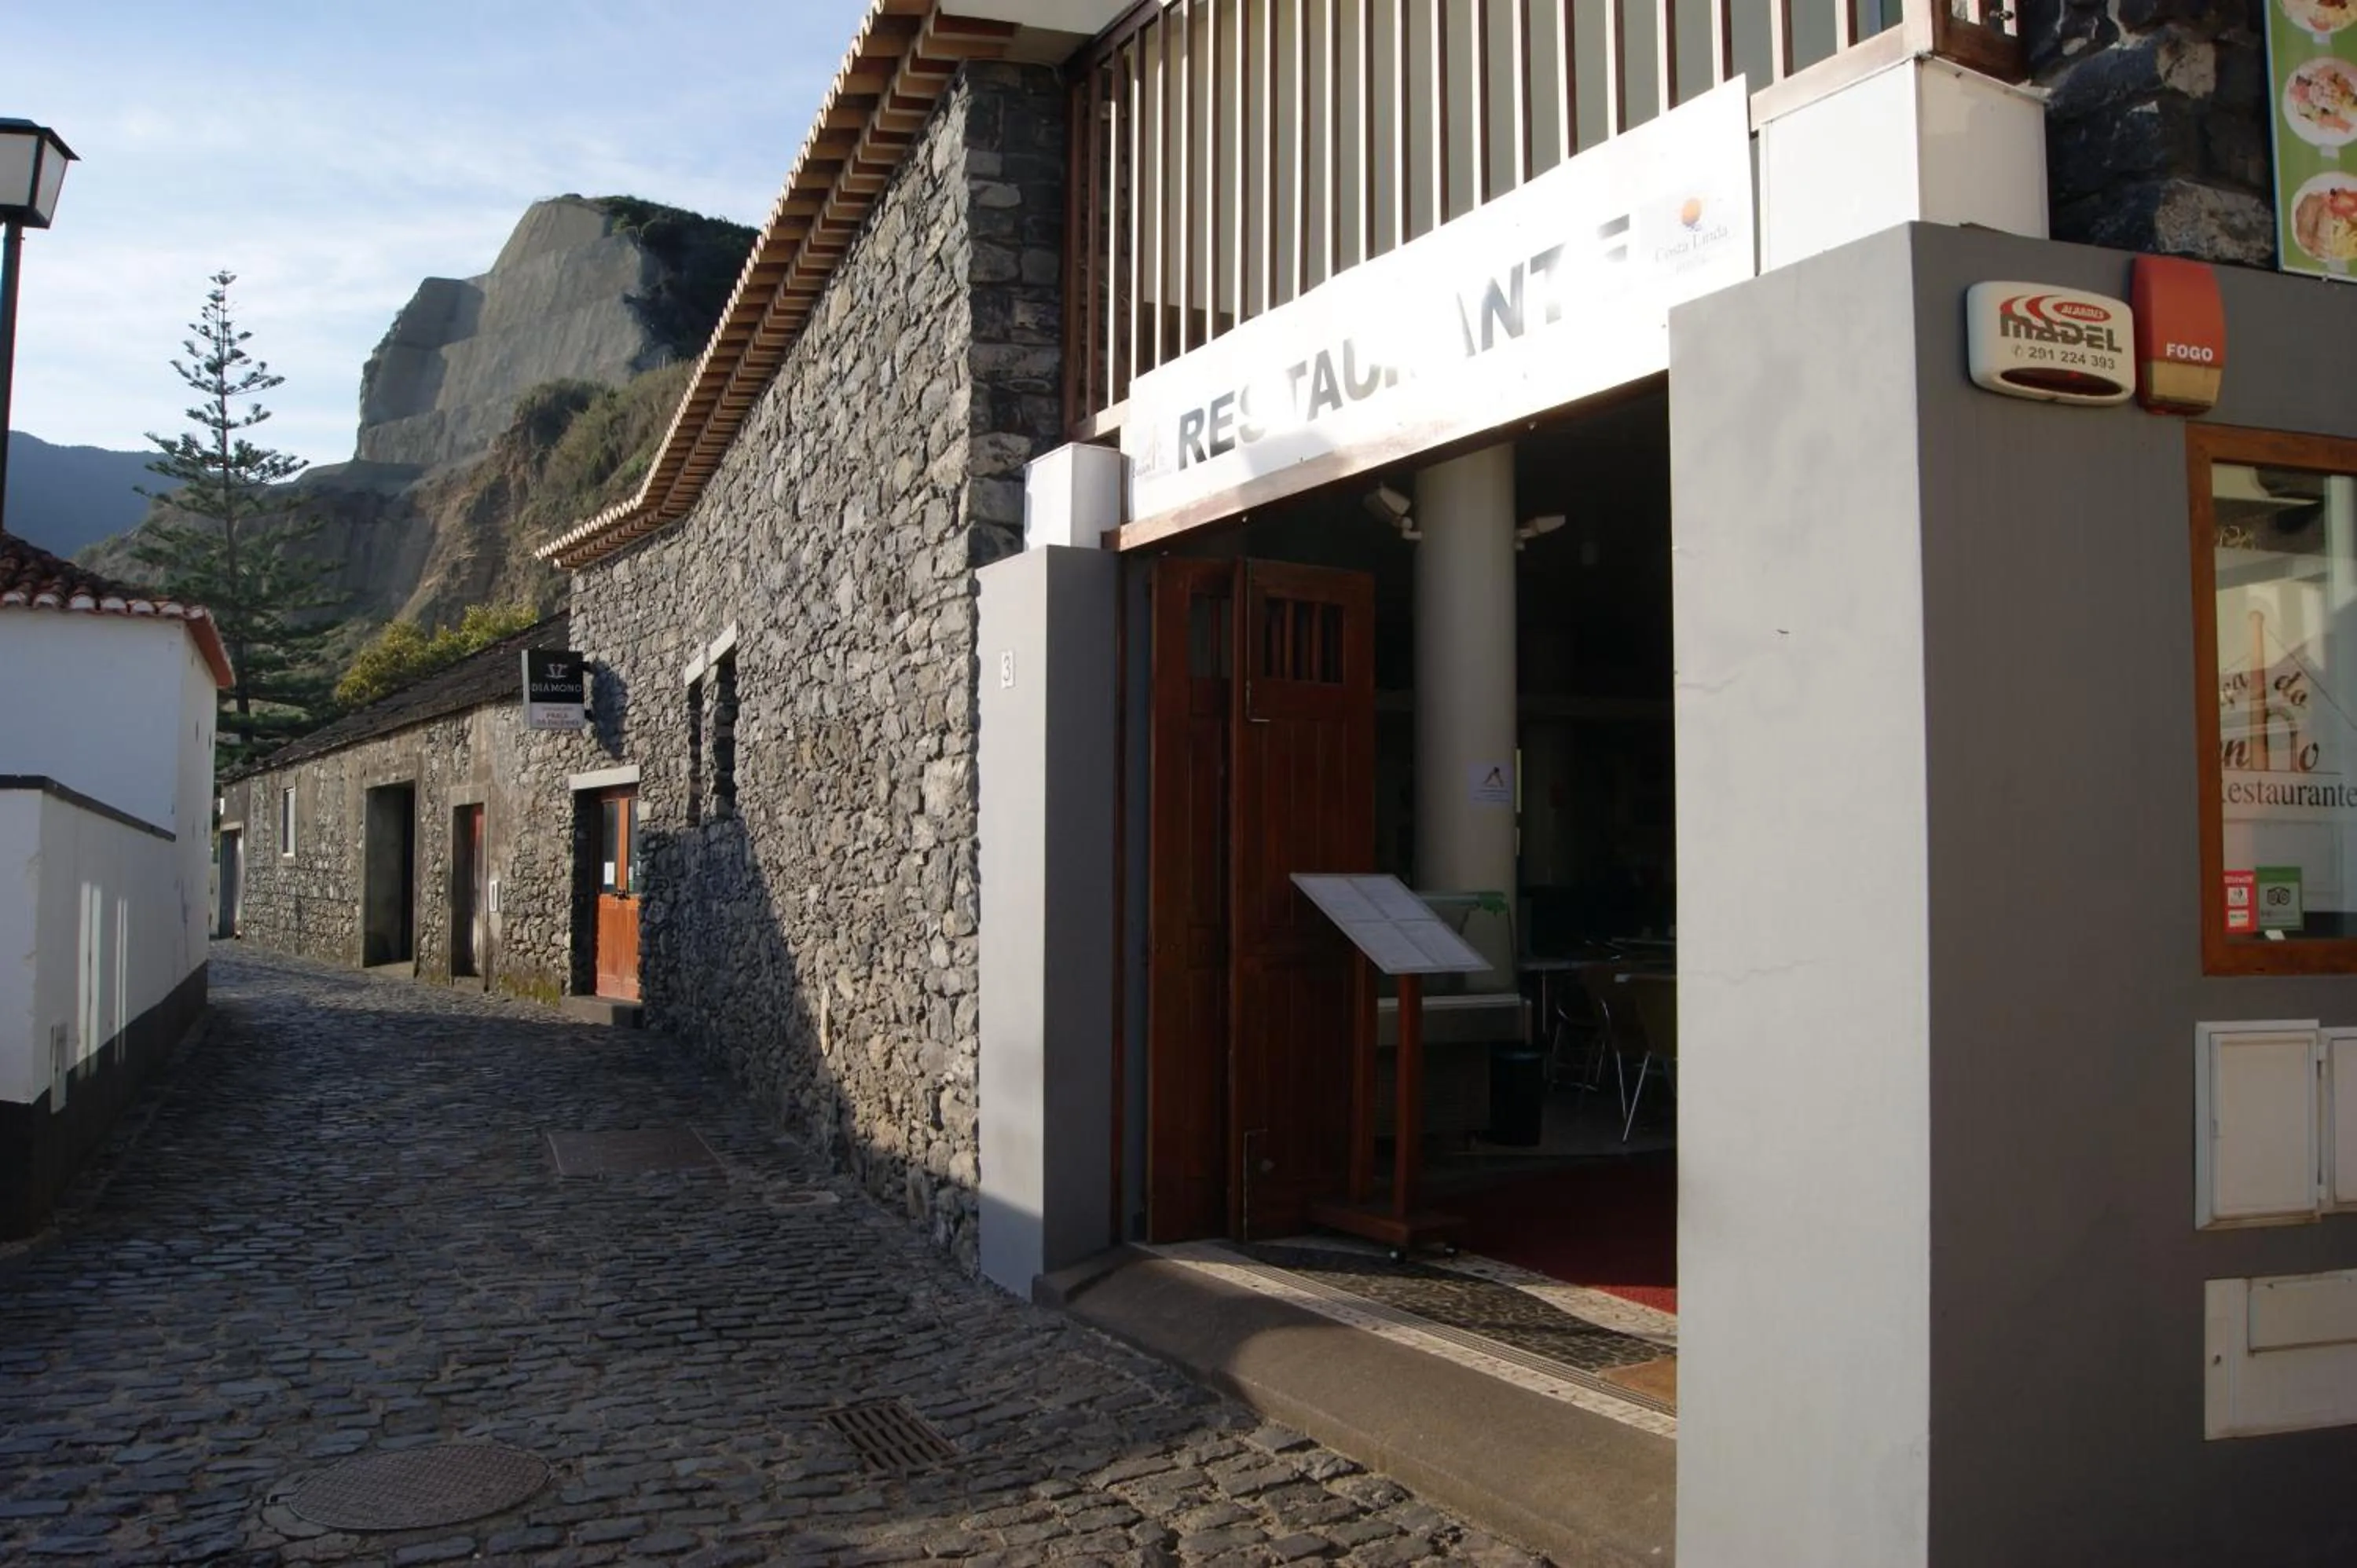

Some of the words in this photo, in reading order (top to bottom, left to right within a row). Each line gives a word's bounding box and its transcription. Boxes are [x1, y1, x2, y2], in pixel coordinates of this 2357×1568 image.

[2028, 346, 2055, 361] 291
[2059, 350, 2087, 365] 224
[2090, 354, 2116, 370] 393
[2165, 343, 2214, 362] FOGO
[1003, 654, 1011, 682] 3
[531, 681, 582, 693] DIAMOND
[2221, 779, 2357, 808] estaurante
